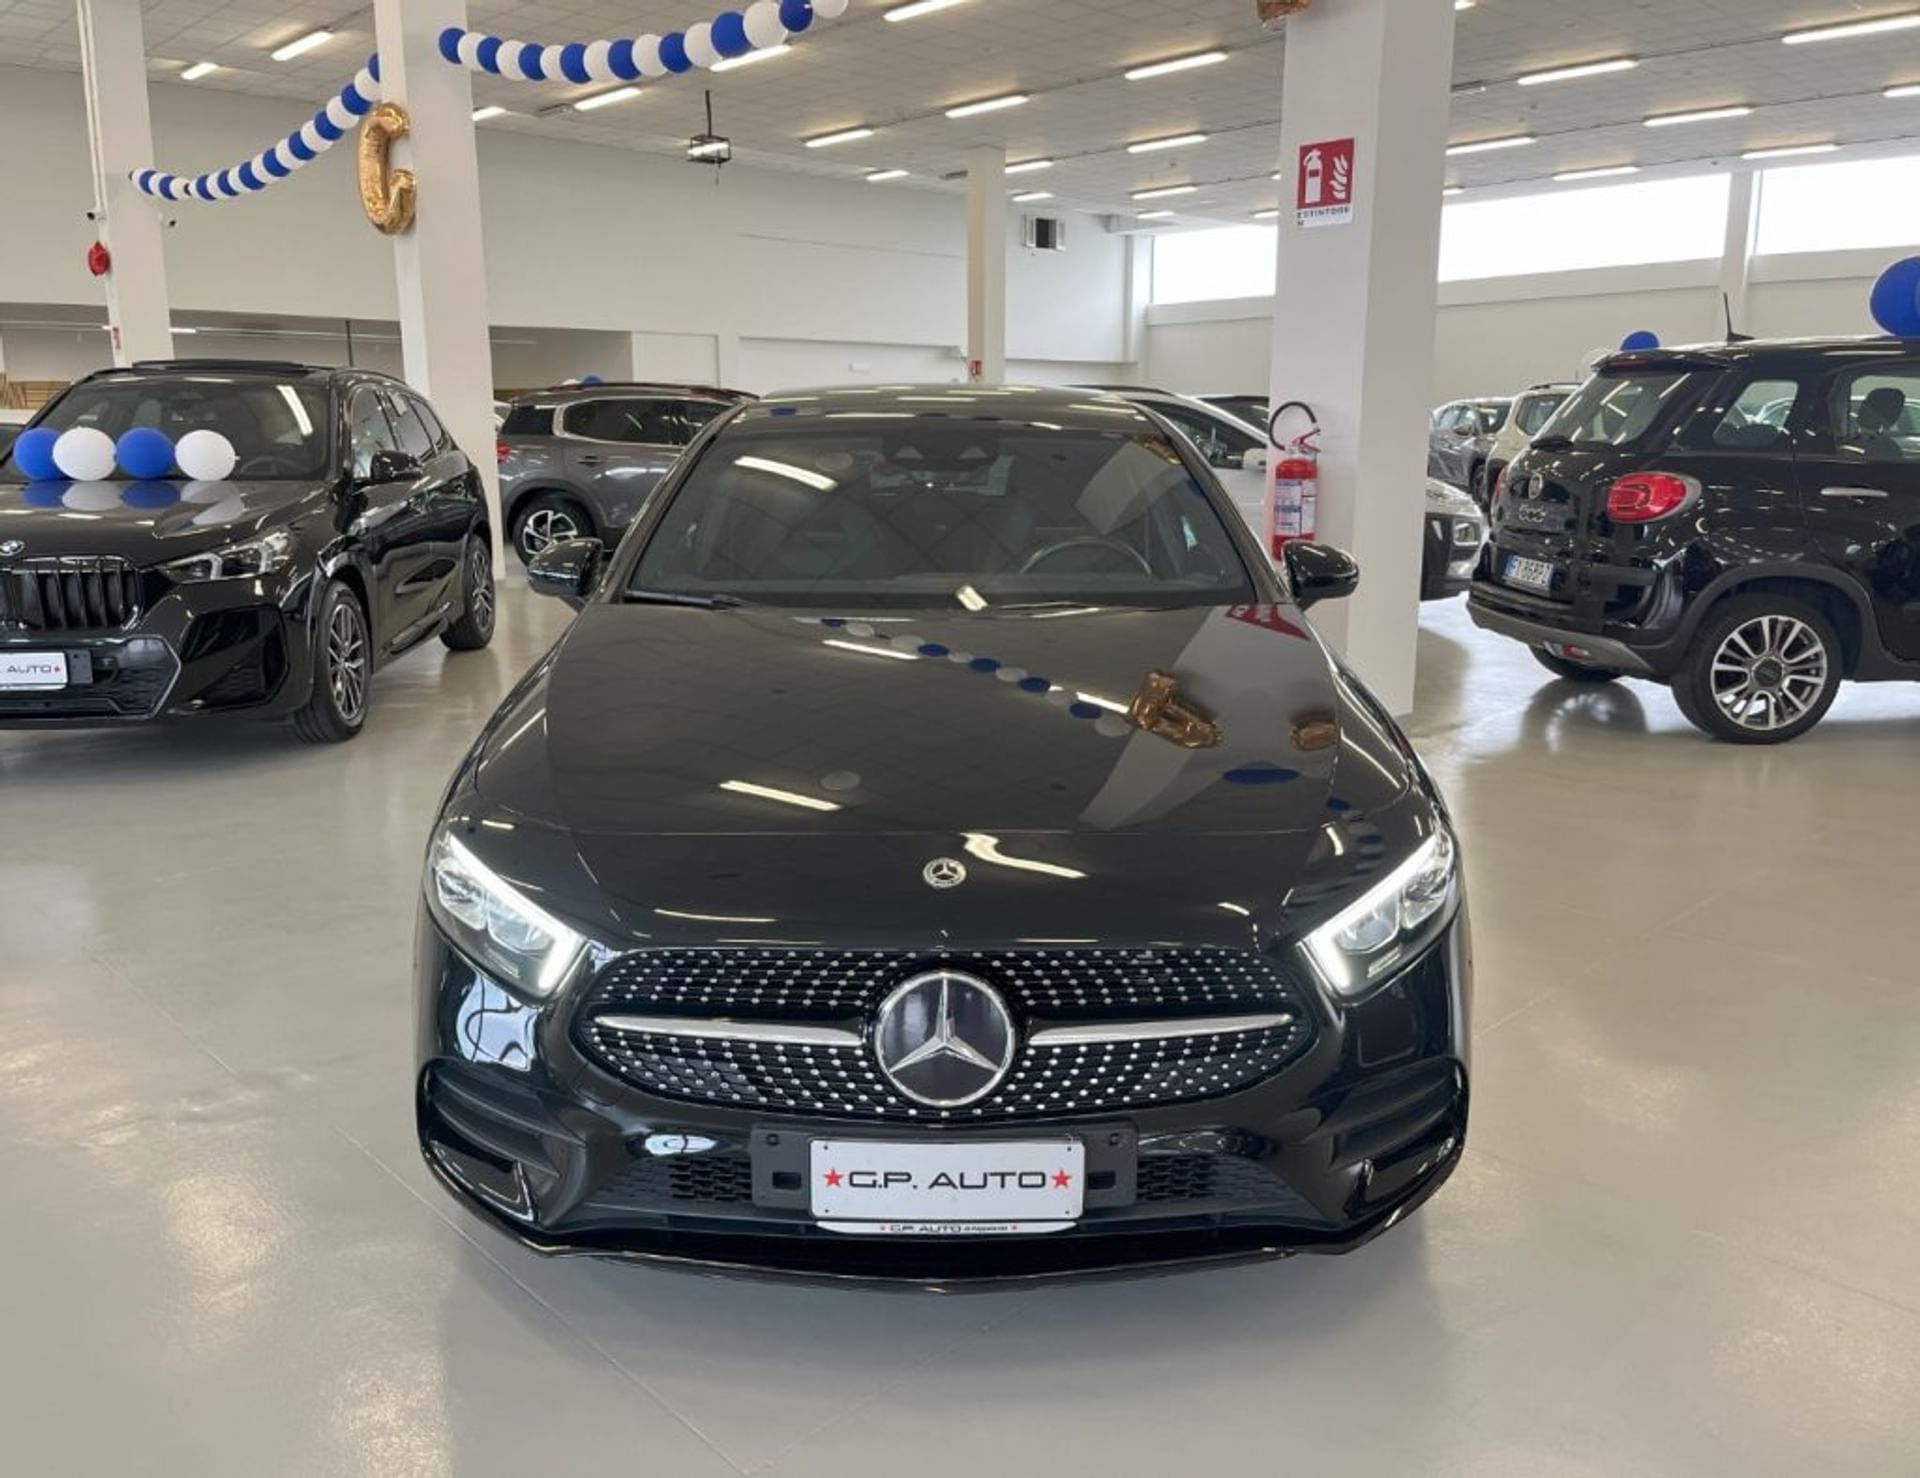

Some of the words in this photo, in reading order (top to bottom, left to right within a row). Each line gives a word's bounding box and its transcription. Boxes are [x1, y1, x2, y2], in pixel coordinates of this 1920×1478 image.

[7, 665, 52, 674] AUTO
[849, 1171, 918, 1189] G.P.
[928, 1171, 1047, 1190] AUTO
[919, 1224, 961, 1232] AUTO
